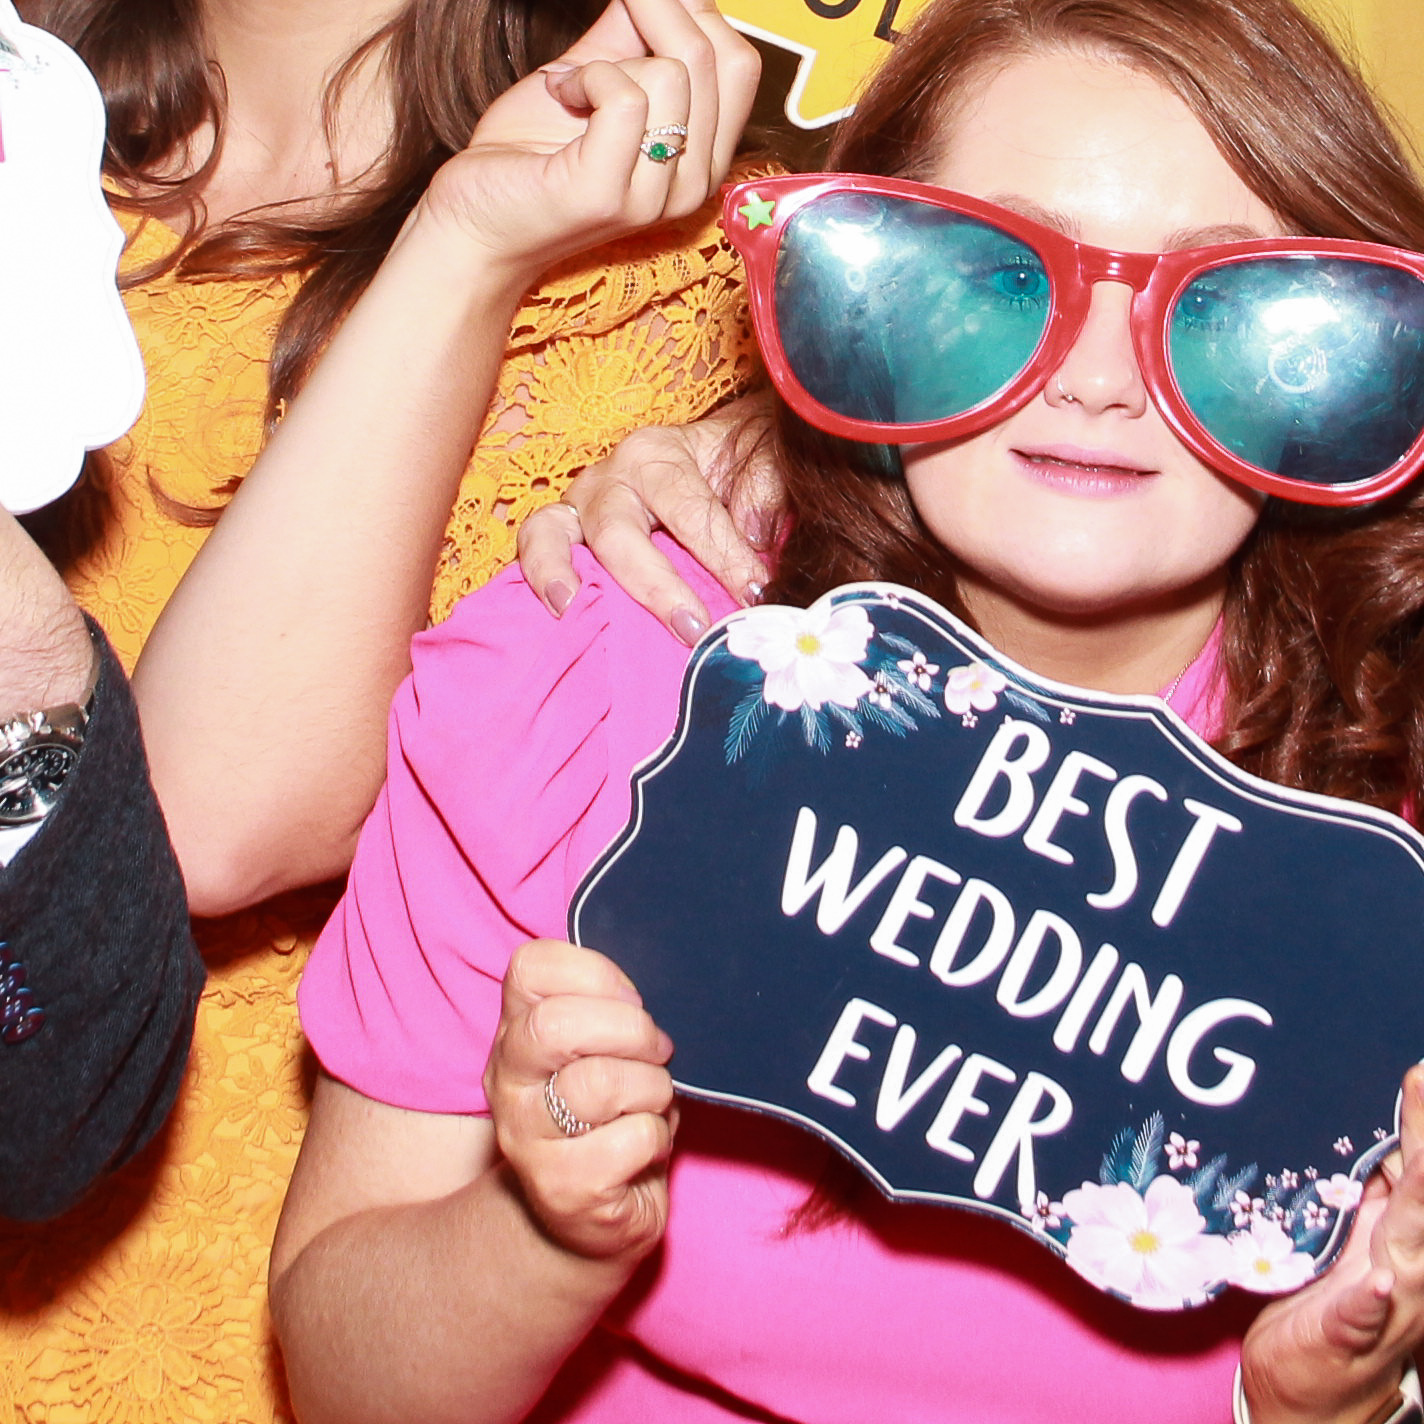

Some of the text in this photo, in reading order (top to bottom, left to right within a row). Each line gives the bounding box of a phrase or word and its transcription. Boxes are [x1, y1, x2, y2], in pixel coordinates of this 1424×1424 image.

[954, 719, 1243, 927] BEST
[781, 806, 1273, 1106] WEDDING
[806, 997, 1074, 1207] EVER
